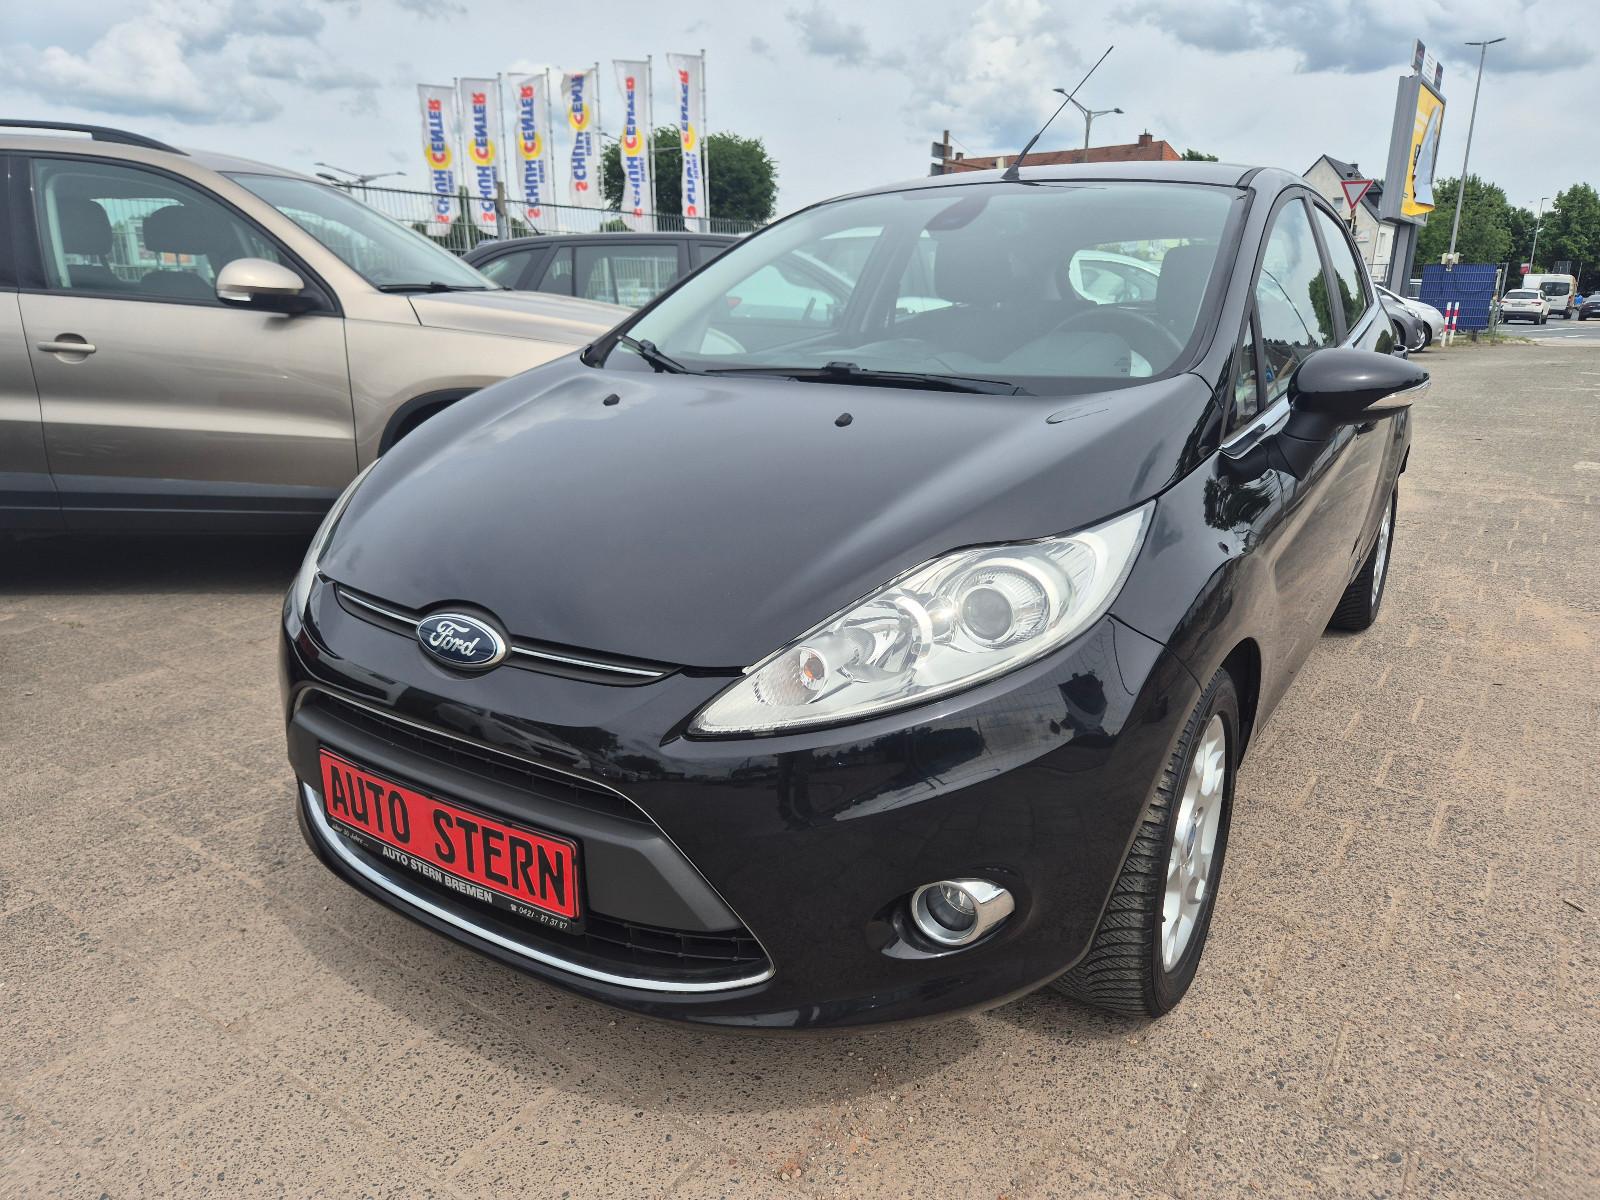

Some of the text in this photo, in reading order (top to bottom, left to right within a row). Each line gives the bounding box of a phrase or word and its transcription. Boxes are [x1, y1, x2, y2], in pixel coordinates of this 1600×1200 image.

[429, 620, 480, 657] Ford
[331, 765, 566, 907] AUTO STERN
[382, 846, 493, 904] AUTO STERN BREMEN
[519, 906, 535, 918] 0421
